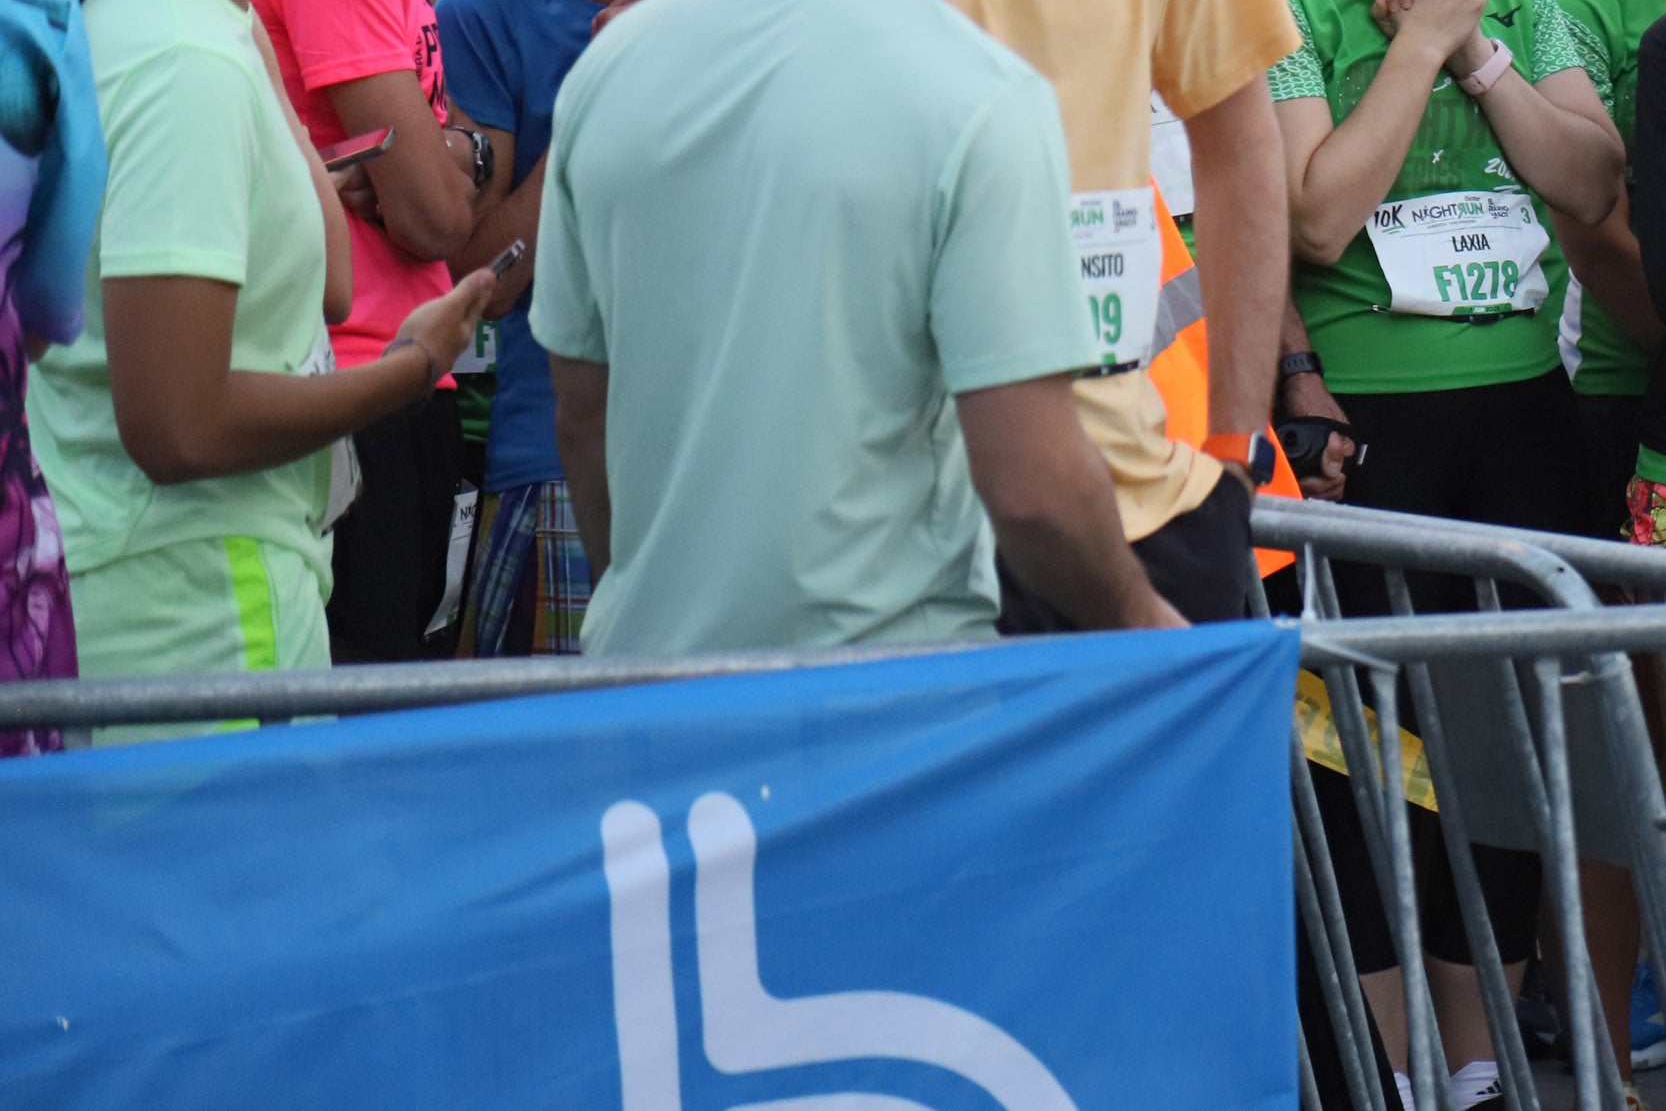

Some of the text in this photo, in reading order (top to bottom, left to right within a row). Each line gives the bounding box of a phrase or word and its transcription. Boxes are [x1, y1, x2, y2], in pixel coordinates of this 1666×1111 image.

[1374, 203, 1405, 229] 10K
[1520, 207, 1532, 224] 3
[1451, 233, 1491, 253] LAXIA
[1433, 259, 1519, 302] F1278
